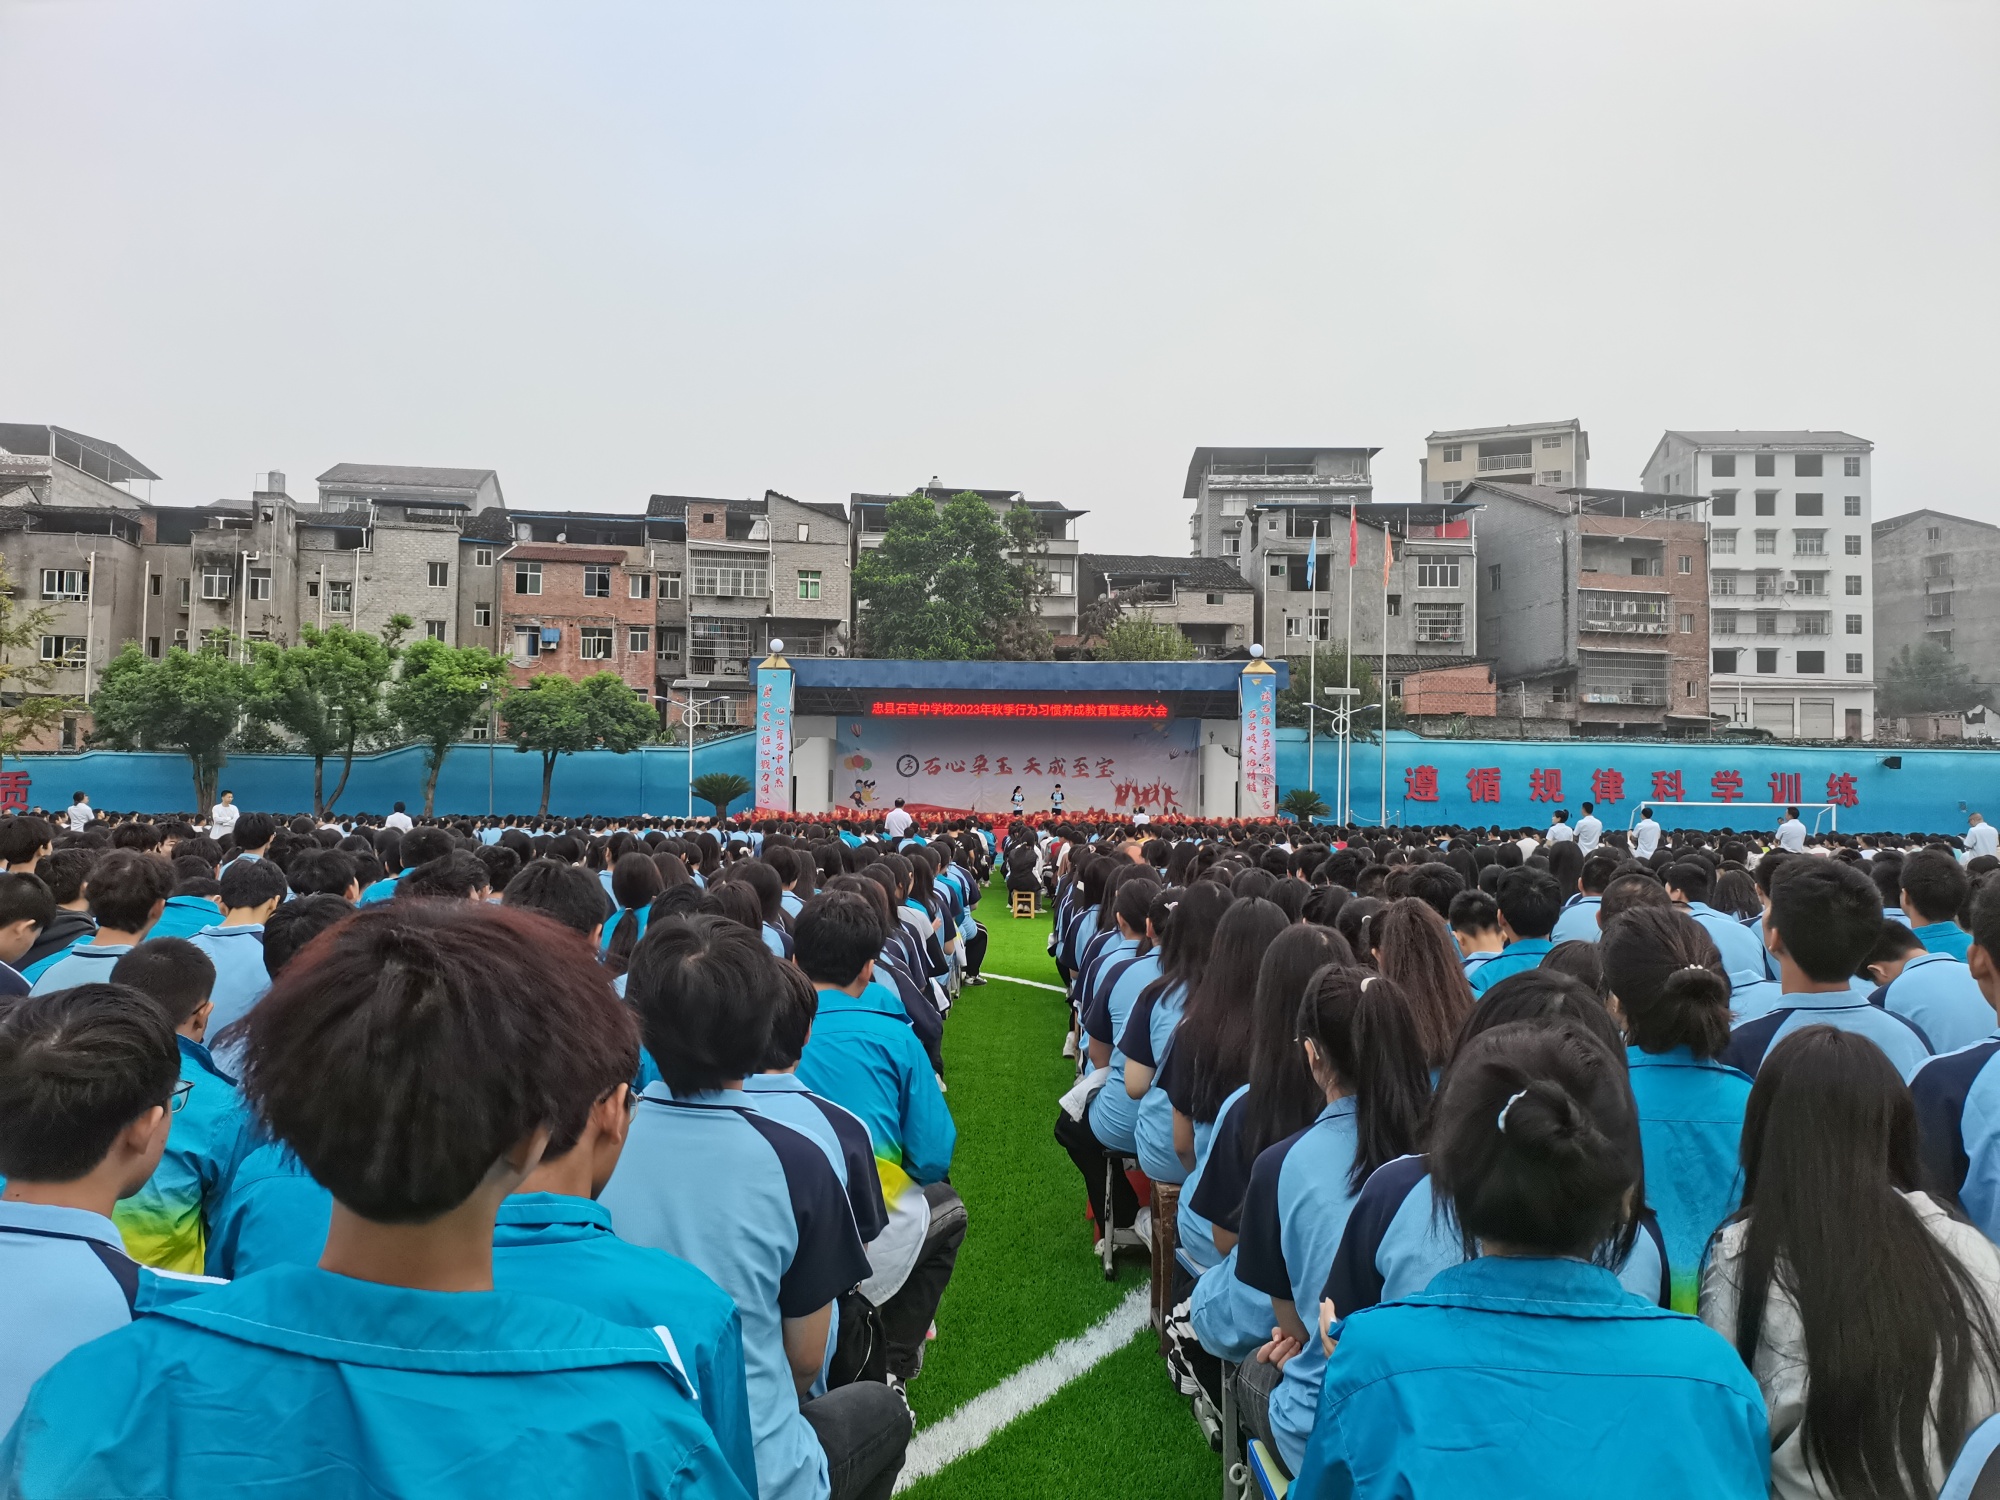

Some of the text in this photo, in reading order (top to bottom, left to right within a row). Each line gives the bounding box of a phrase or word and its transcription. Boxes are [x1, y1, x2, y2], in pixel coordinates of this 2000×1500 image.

[871, 701, 1169, 718] 忠县石宝中学校2023年秋季行为习惯养成教育暨表彰大会
